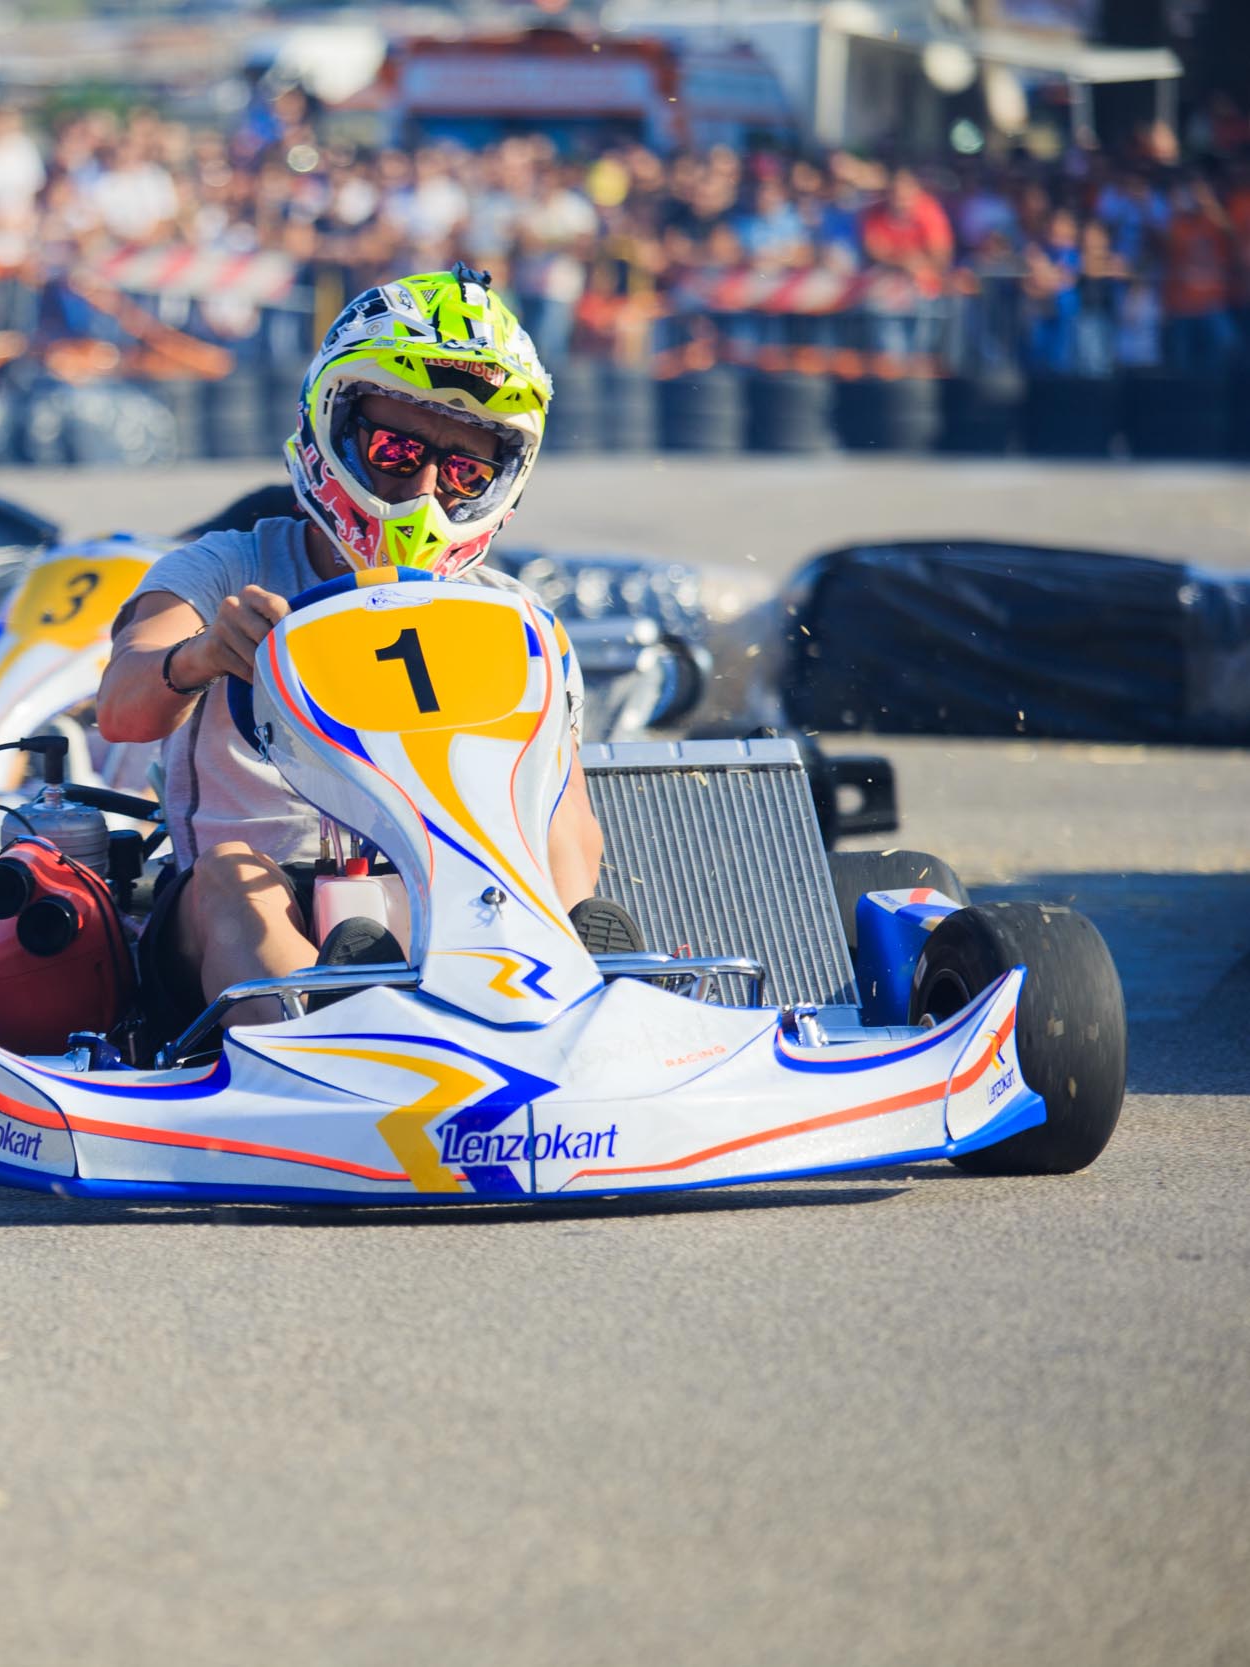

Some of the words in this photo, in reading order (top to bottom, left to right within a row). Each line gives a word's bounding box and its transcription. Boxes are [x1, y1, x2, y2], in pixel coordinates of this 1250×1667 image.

[40, 571, 101, 625] 3
[375, 628, 441, 714] 1
[664, 1045, 727, 1068] RACING
[440, 1124, 619, 1165] Lenzokart
